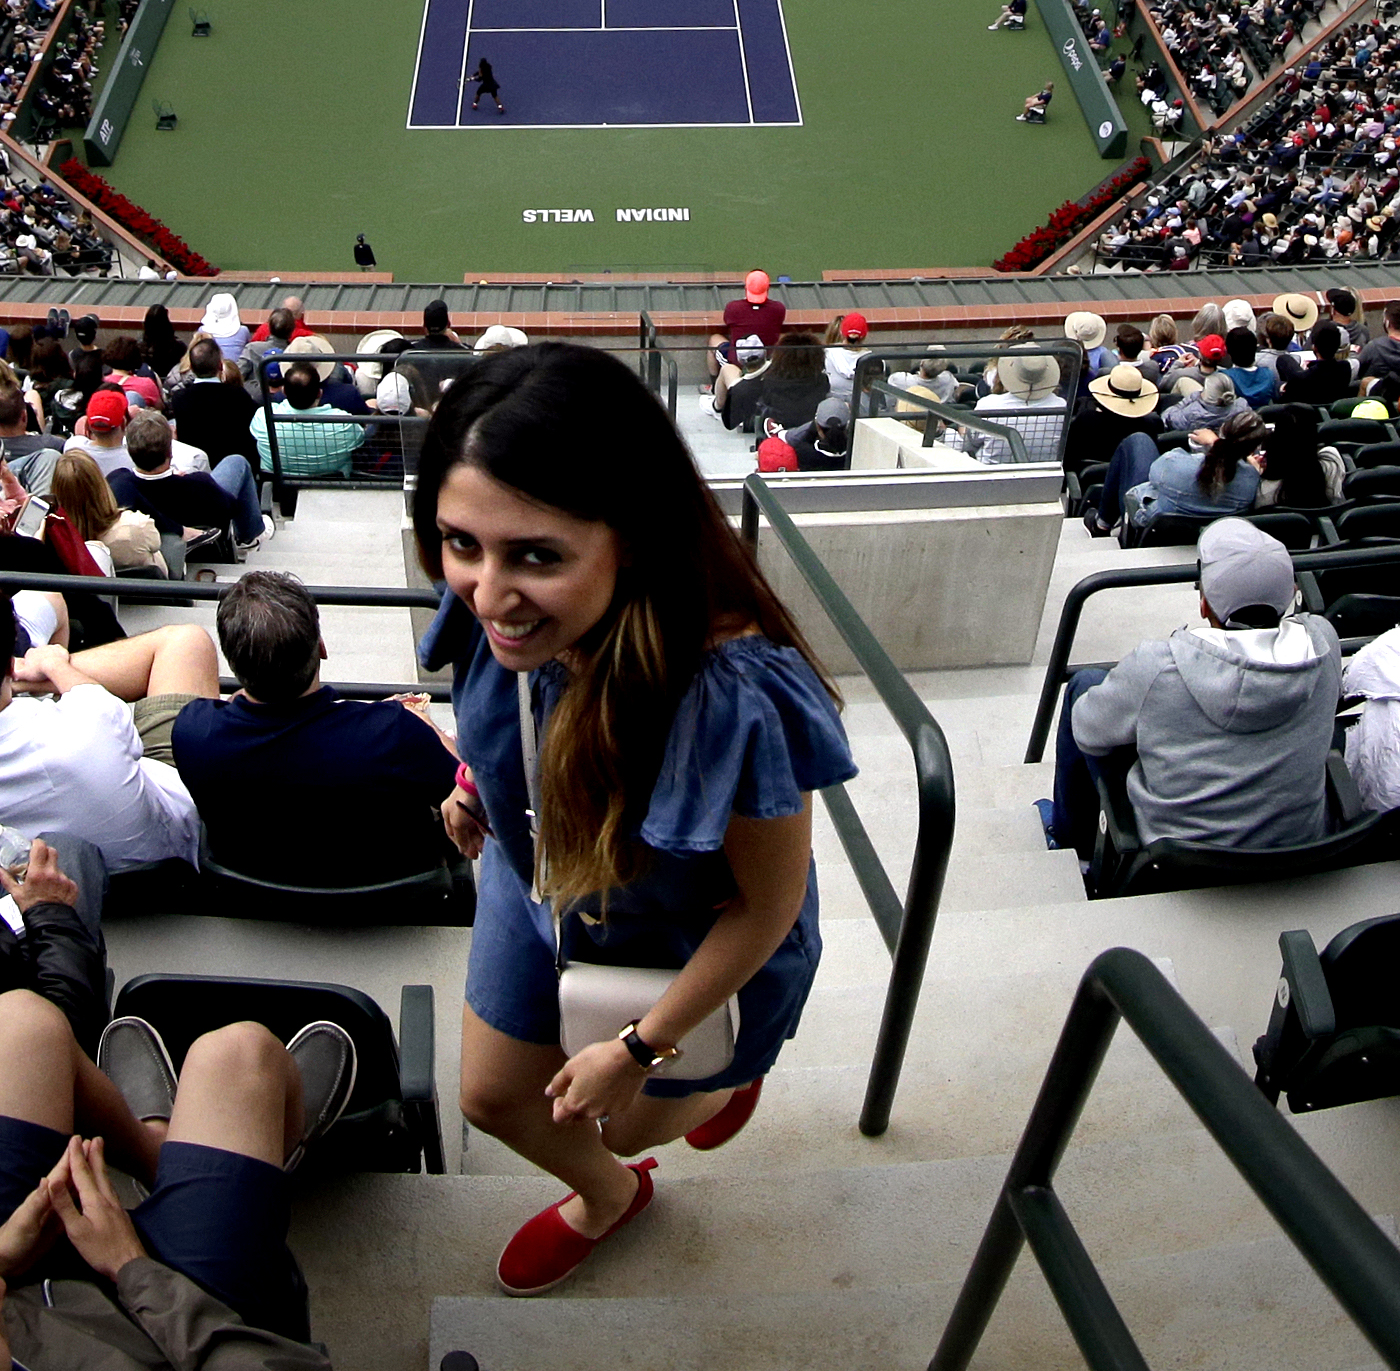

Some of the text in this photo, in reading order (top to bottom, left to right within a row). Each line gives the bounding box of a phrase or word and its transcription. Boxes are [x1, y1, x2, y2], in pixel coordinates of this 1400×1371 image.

[100, 118, 111, 141] ATP
[523, 208, 690, 223] INDIAN WELLS
